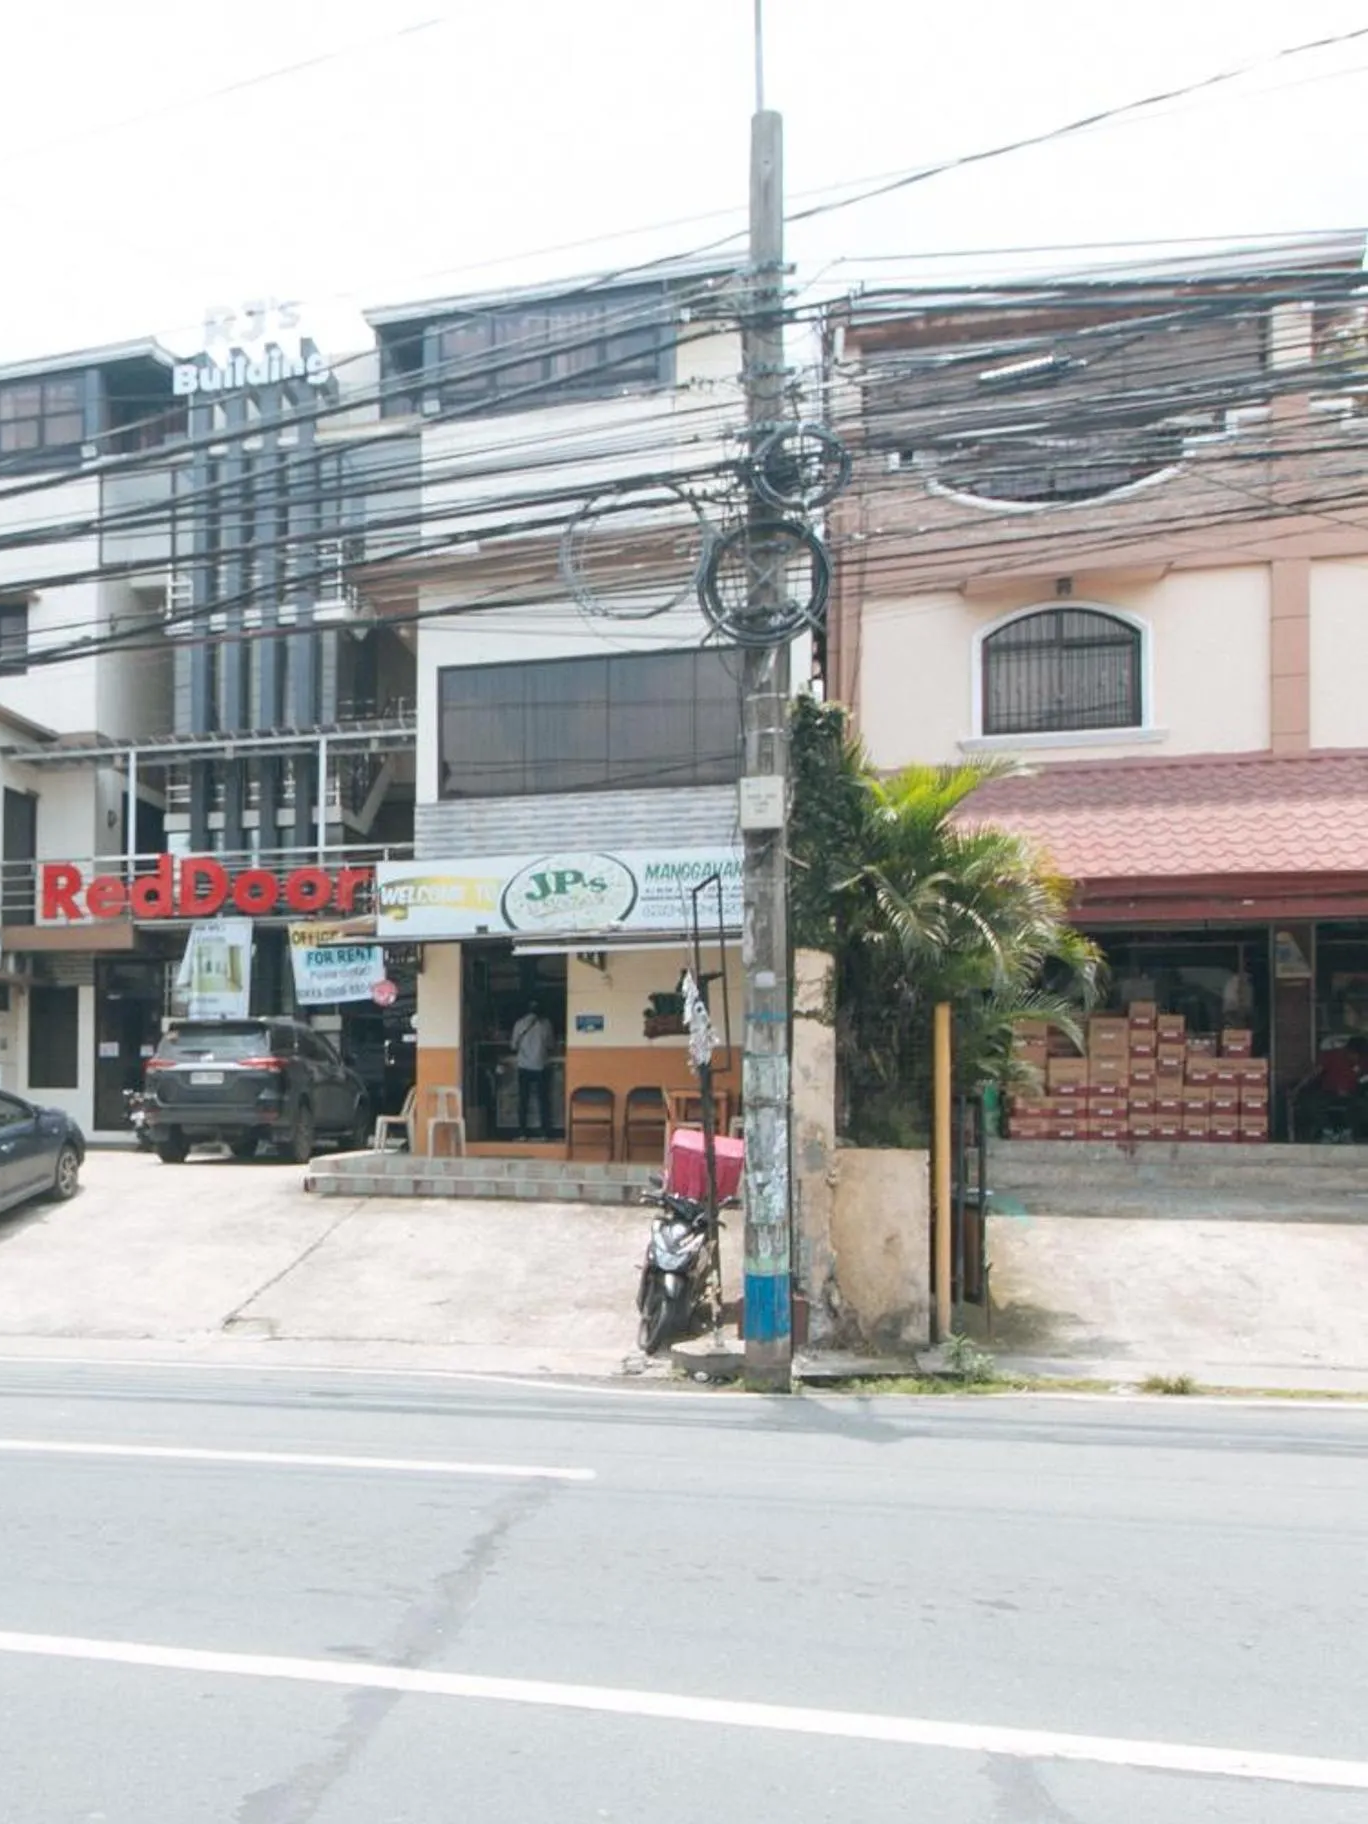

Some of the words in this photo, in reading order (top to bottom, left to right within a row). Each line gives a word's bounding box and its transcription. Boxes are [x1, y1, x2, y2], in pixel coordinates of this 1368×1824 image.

[172, 349, 329, 396] Building
[306, 951, 332, 966] FOR
[336, 945, 374, 963] RENT
